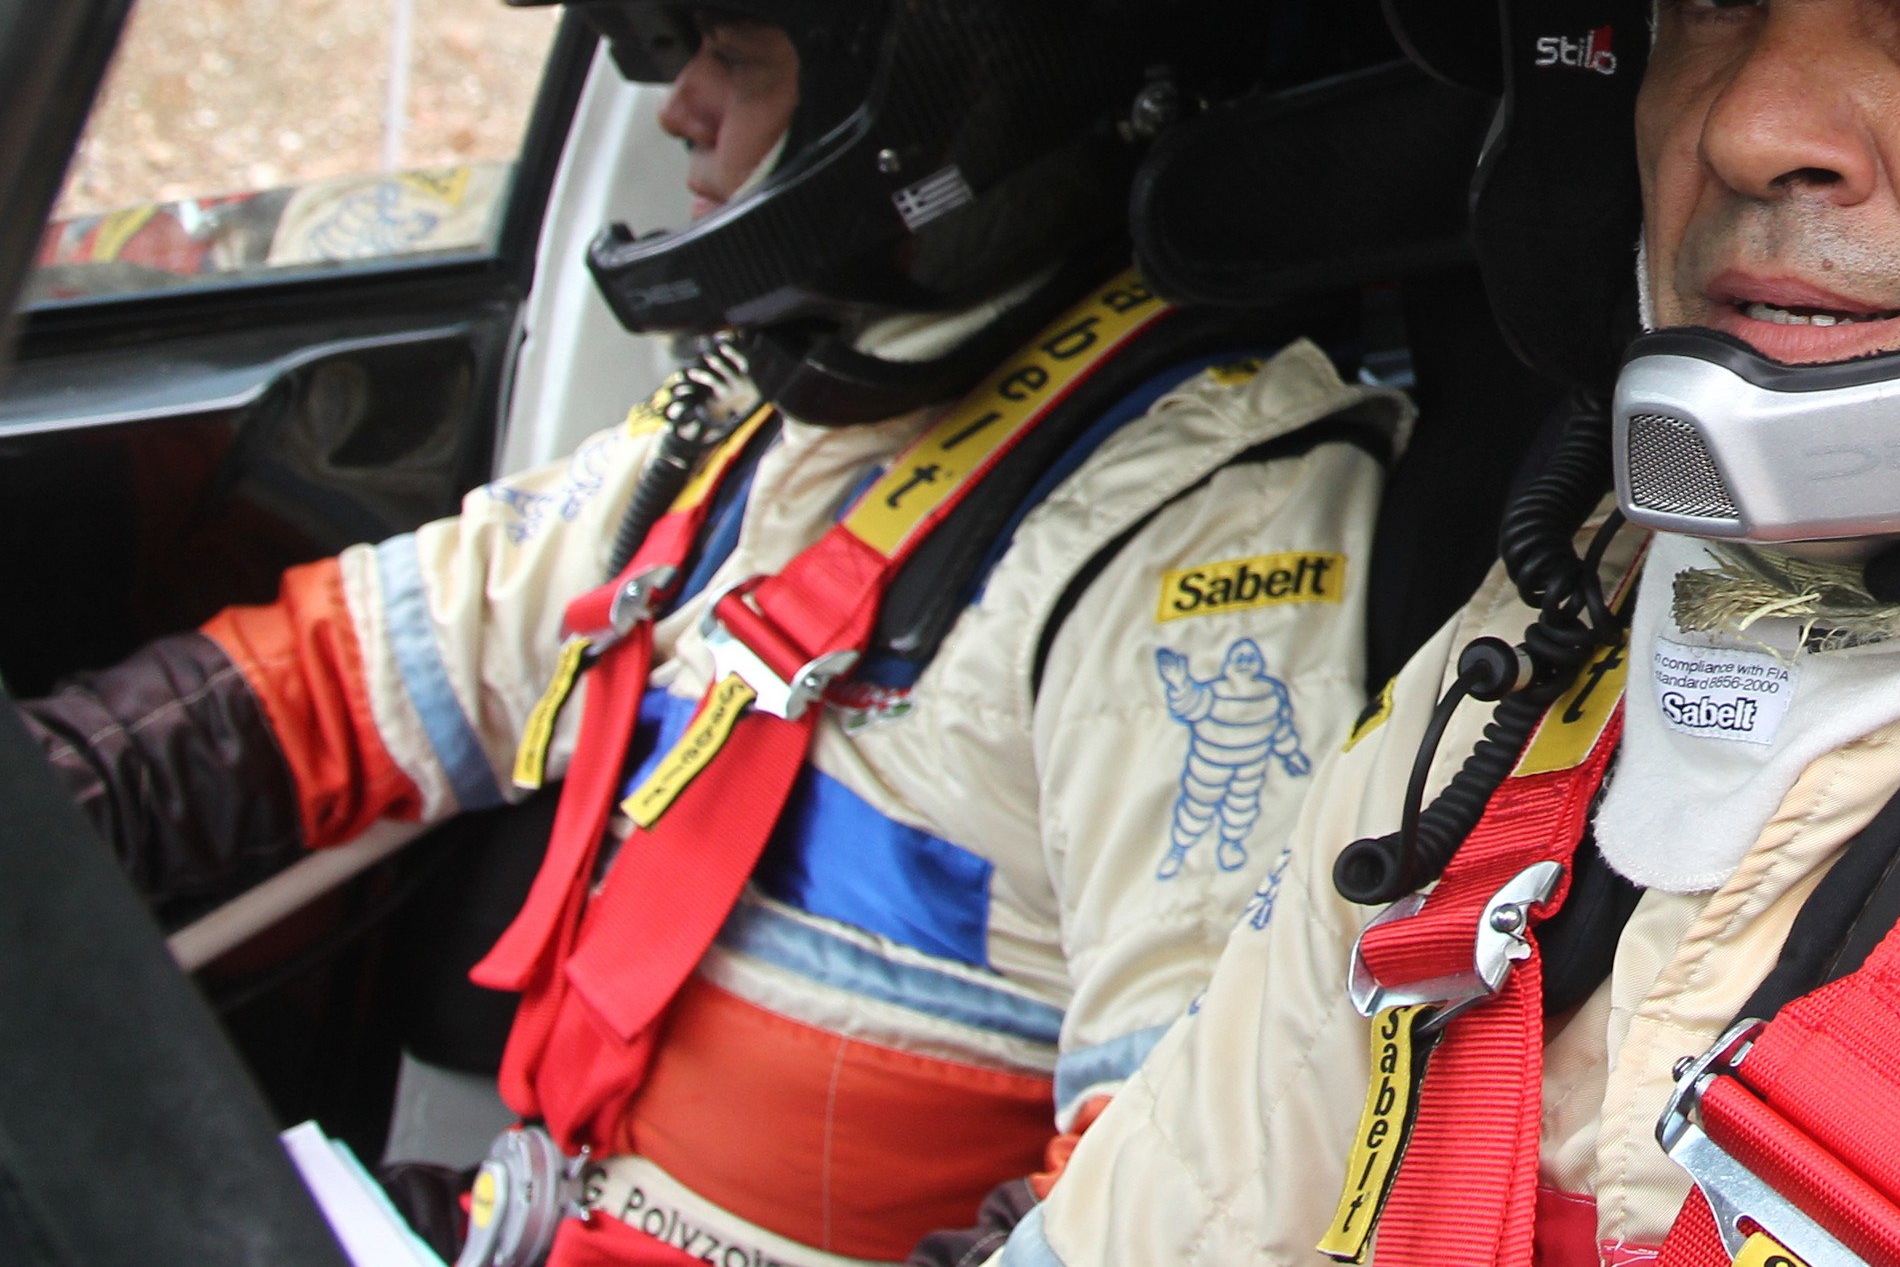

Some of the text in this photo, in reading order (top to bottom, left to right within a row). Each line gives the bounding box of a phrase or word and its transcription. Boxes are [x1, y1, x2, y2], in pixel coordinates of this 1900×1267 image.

[886, 284, 1153, 509] abelt
[1173, 556, 1331, 612] Sabelt
[1662, 656, 1735, 675] compliance
[1736, 662, 1764, 677] with
[1766, 667, 1789, 682] FIA
[1662, 691, 1758, 731] Sabelt
[1342, 1004, 1412, 1234] Sabelt
